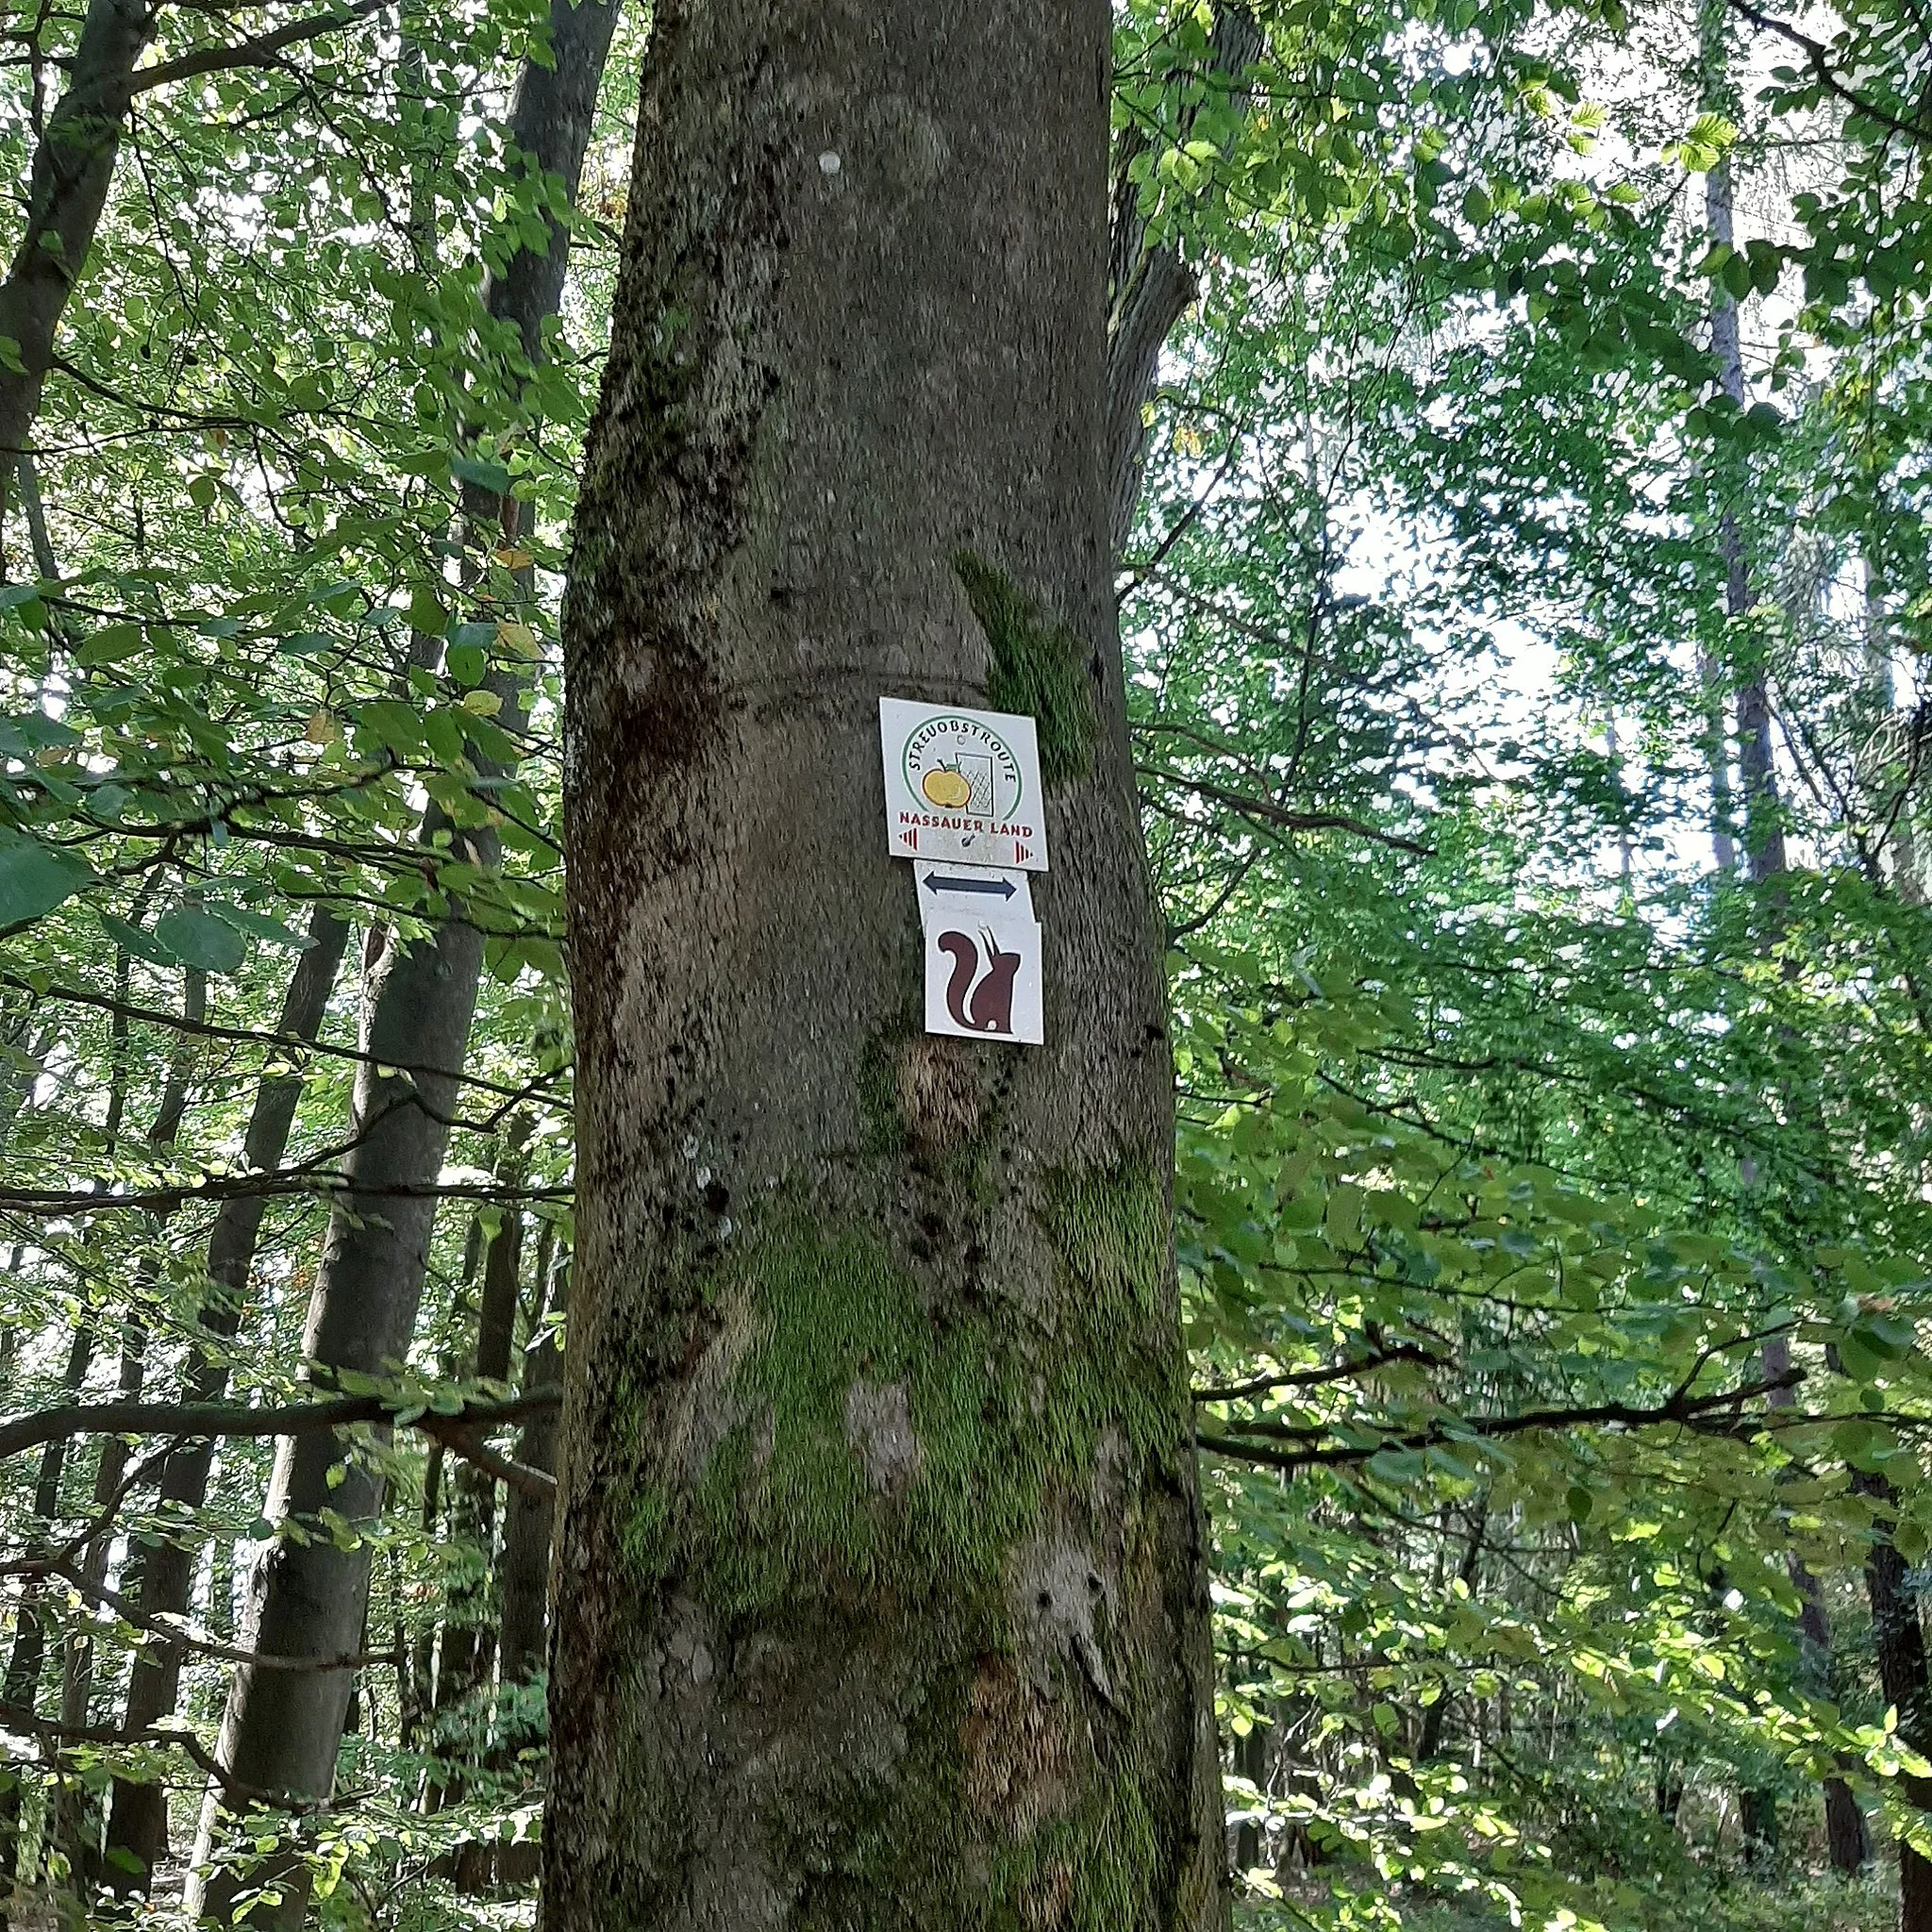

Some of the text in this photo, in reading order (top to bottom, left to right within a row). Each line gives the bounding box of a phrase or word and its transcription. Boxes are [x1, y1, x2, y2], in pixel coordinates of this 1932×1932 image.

[908, 720, 1016, 783] STREUOBSTROUTE
[899, 811, 1033, 838] NASSAUER LAND
